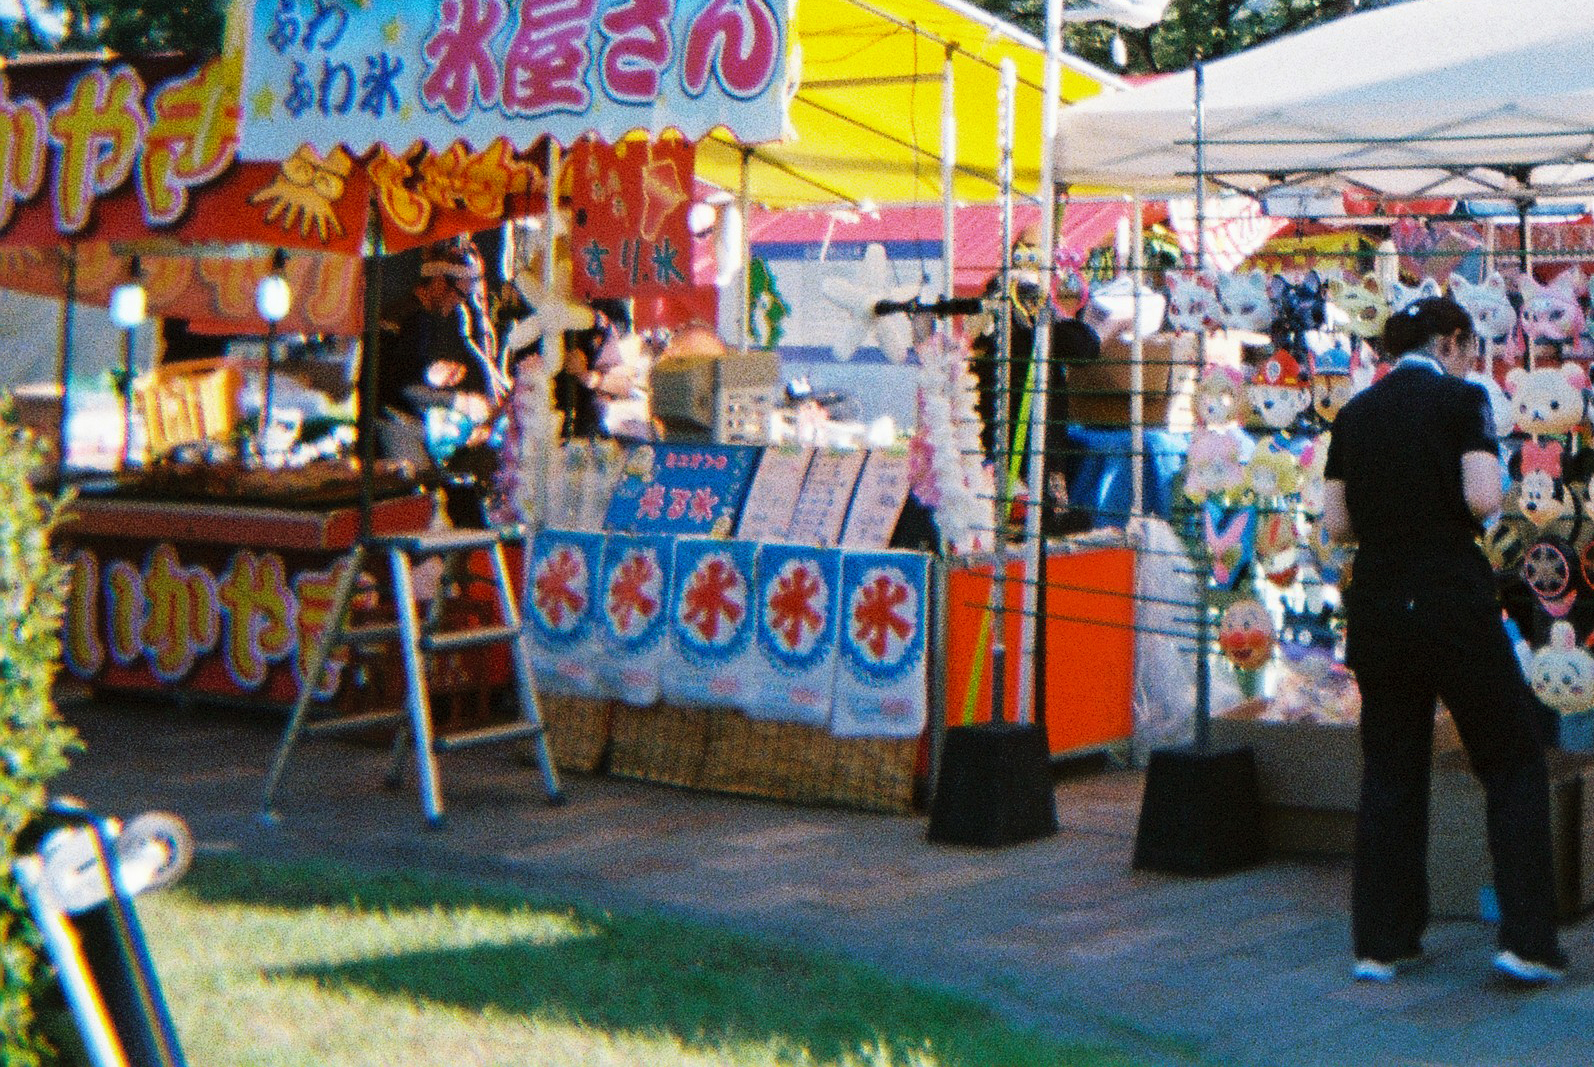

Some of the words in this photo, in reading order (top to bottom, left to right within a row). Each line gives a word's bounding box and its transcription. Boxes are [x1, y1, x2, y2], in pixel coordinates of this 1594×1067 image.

[535, 546, 590, 624] 氷
[607, 548, 662, 629] 氷
[680, 550, 744, 643] 氷
[764, 565, 823, 650] 氷
[852, 570, 912, 659] 氷
